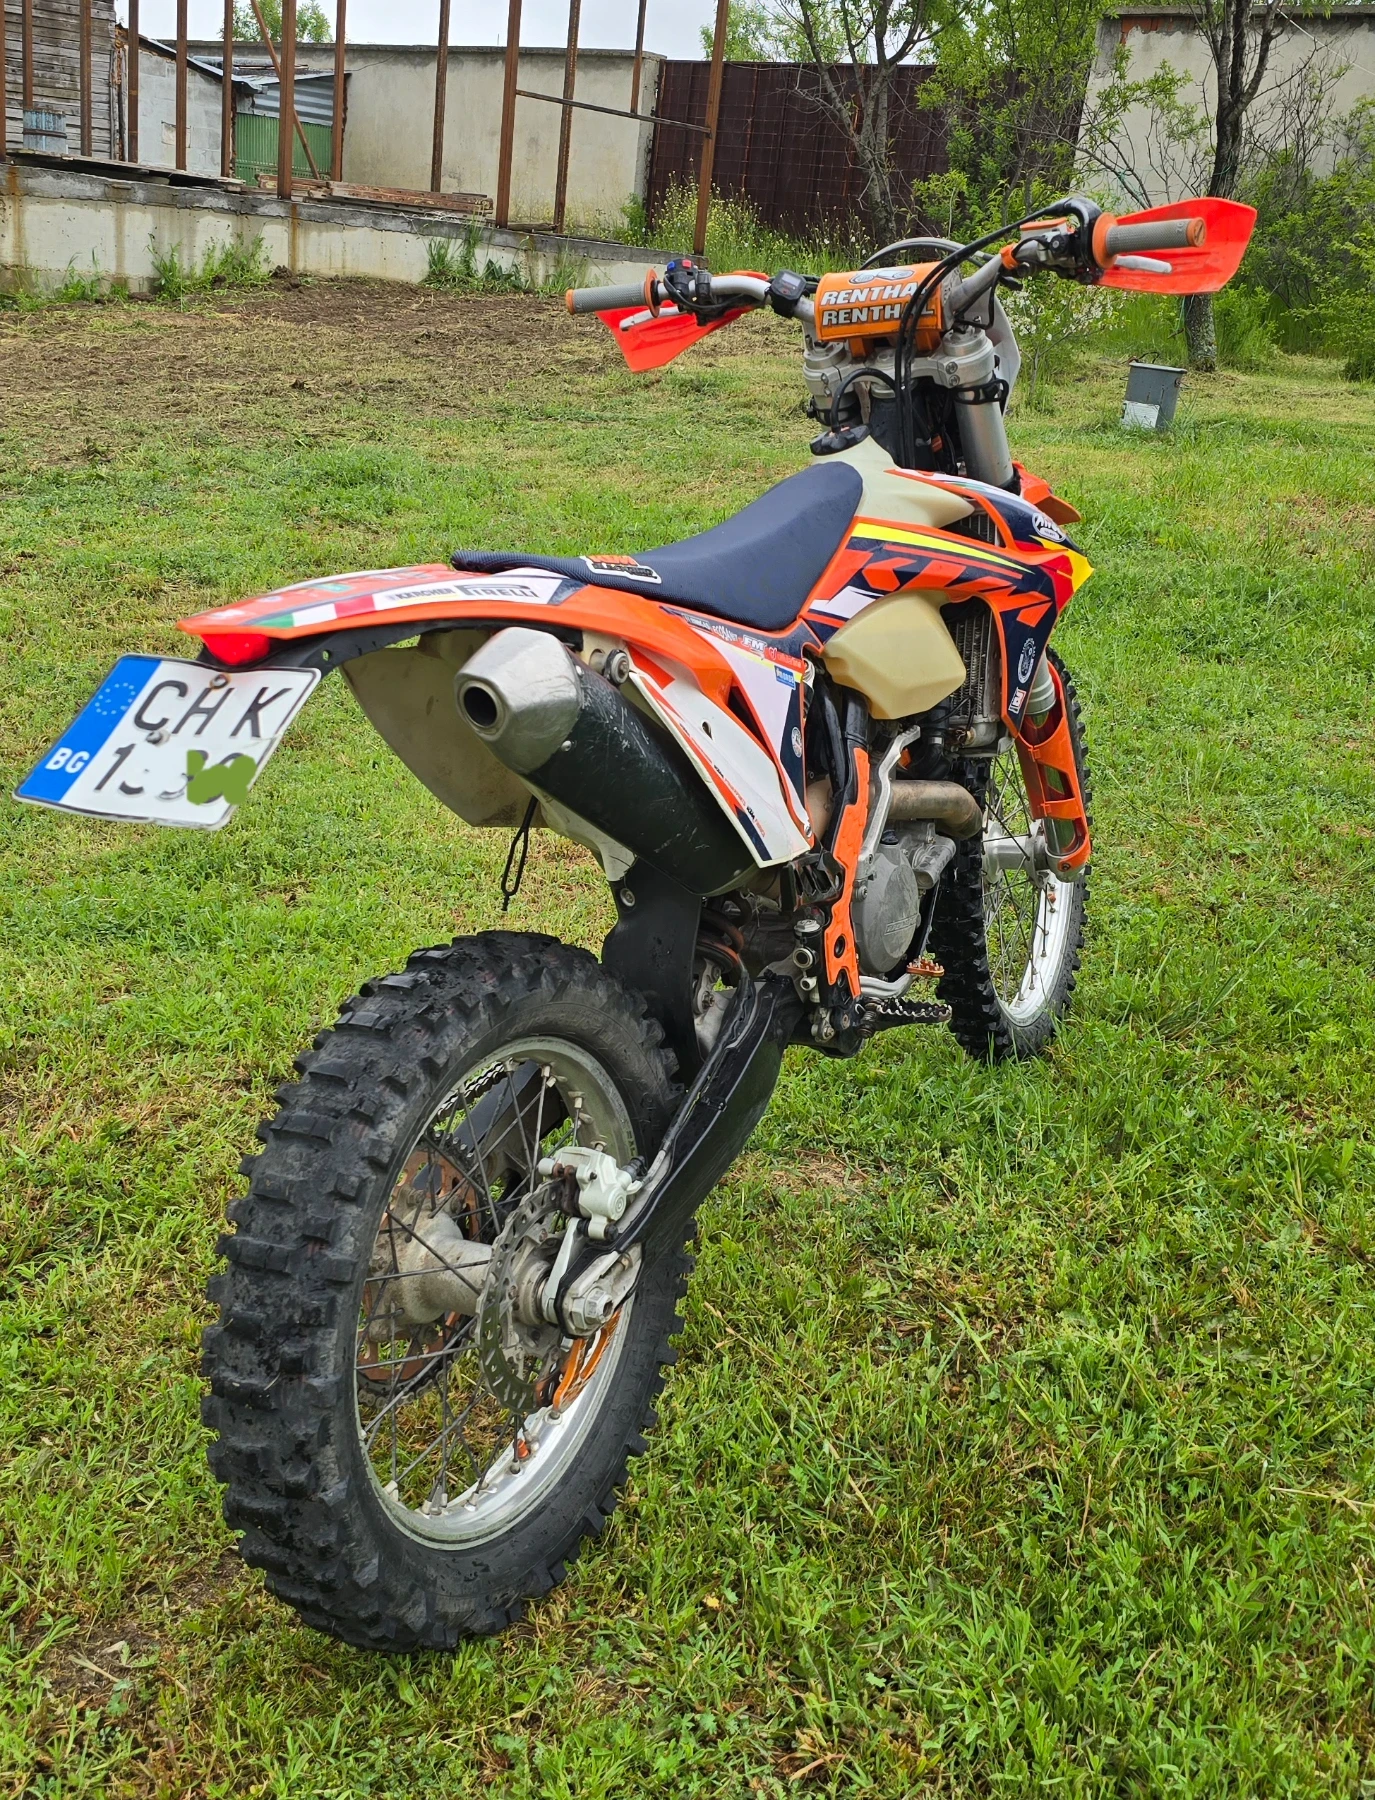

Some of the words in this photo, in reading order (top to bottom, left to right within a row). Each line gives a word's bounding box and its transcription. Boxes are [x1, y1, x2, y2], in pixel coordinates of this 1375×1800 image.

[820, 282, 928, 306] RENTHA
[822, 303, 934, 326] RENTHL
[454, 584, 540, 598] PIRELLI
[45, 747, 90, 773] BG
